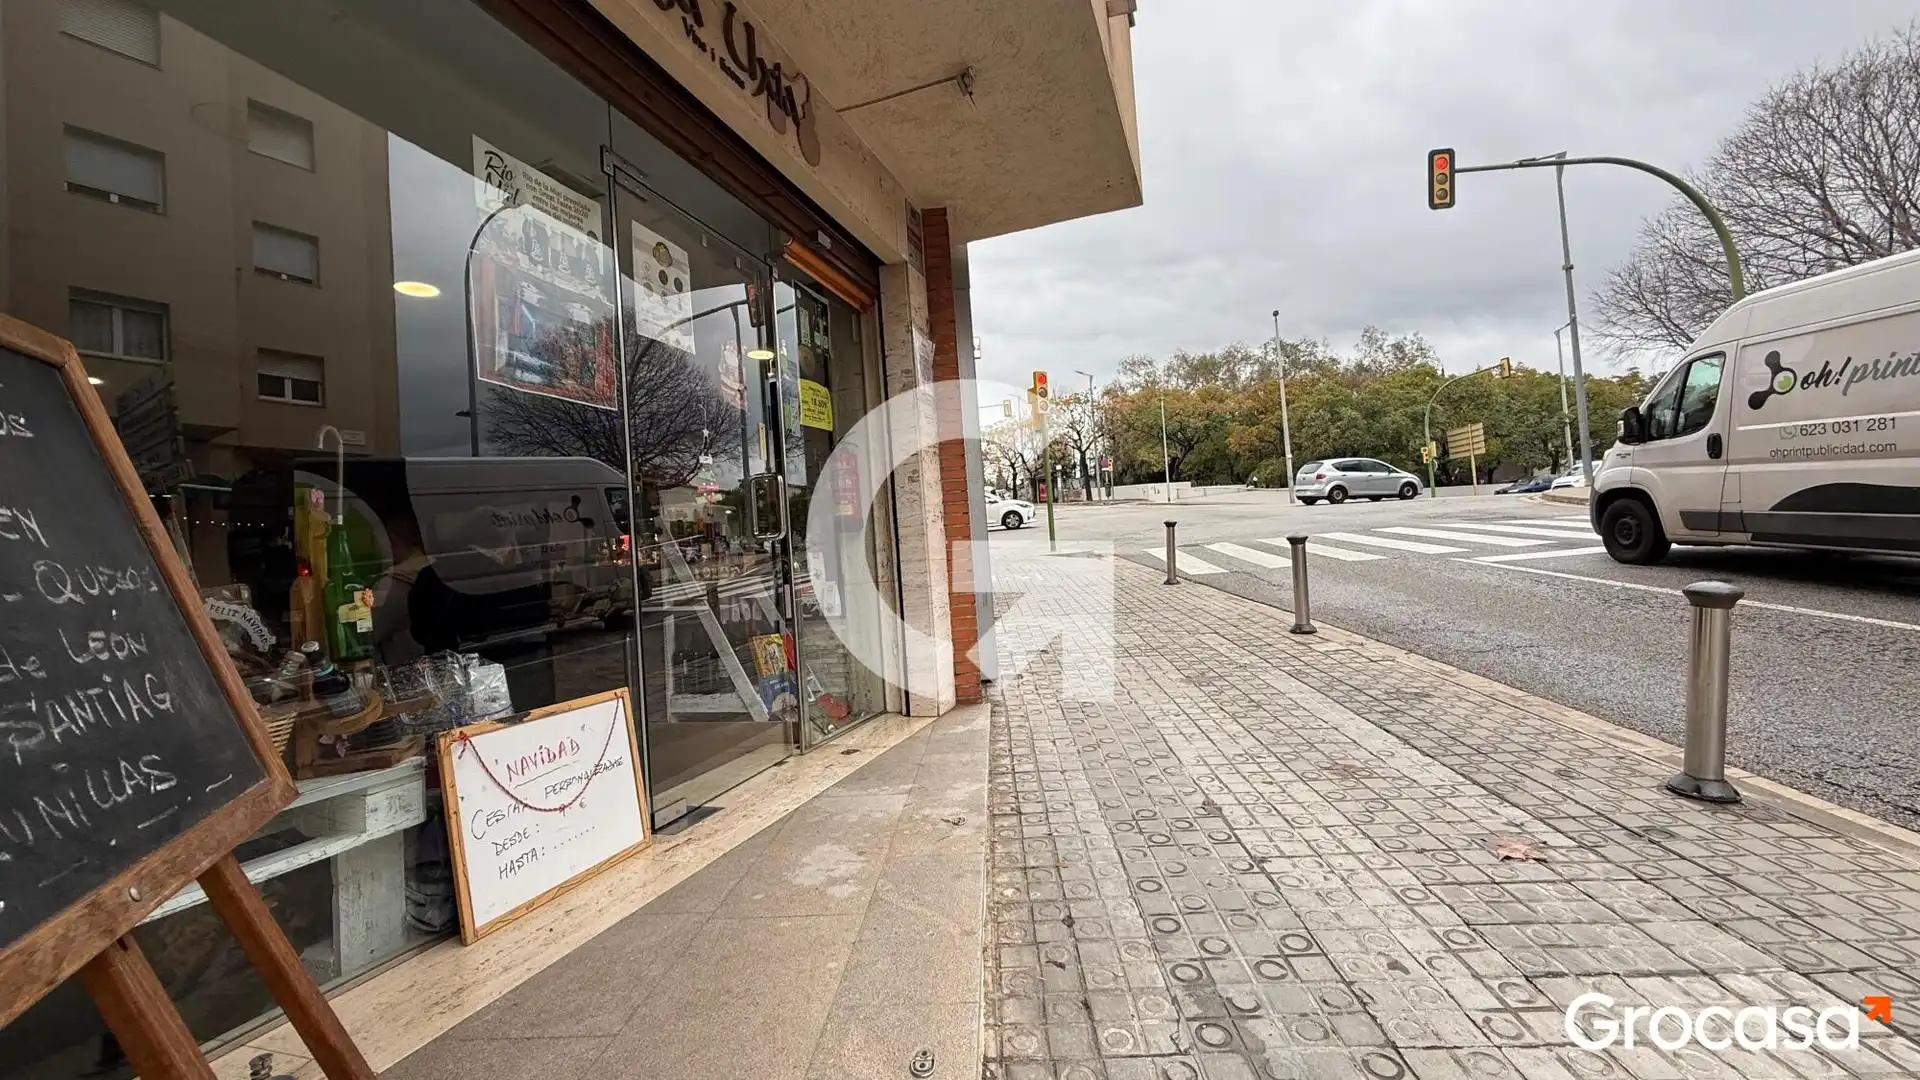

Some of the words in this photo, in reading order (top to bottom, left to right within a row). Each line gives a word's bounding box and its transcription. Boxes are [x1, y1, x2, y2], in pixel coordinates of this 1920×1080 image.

[1800, 423, 1827, 437] 623
[1832, 420, 1860, 434] 031
[1866, 416, 1897, 432] 281
[1769, 443, 1897, 458] ohprintpublicidad.com
[209, 603, 239, 617] FELIZ
[241, 612, 269, 644] NAVIDAD
